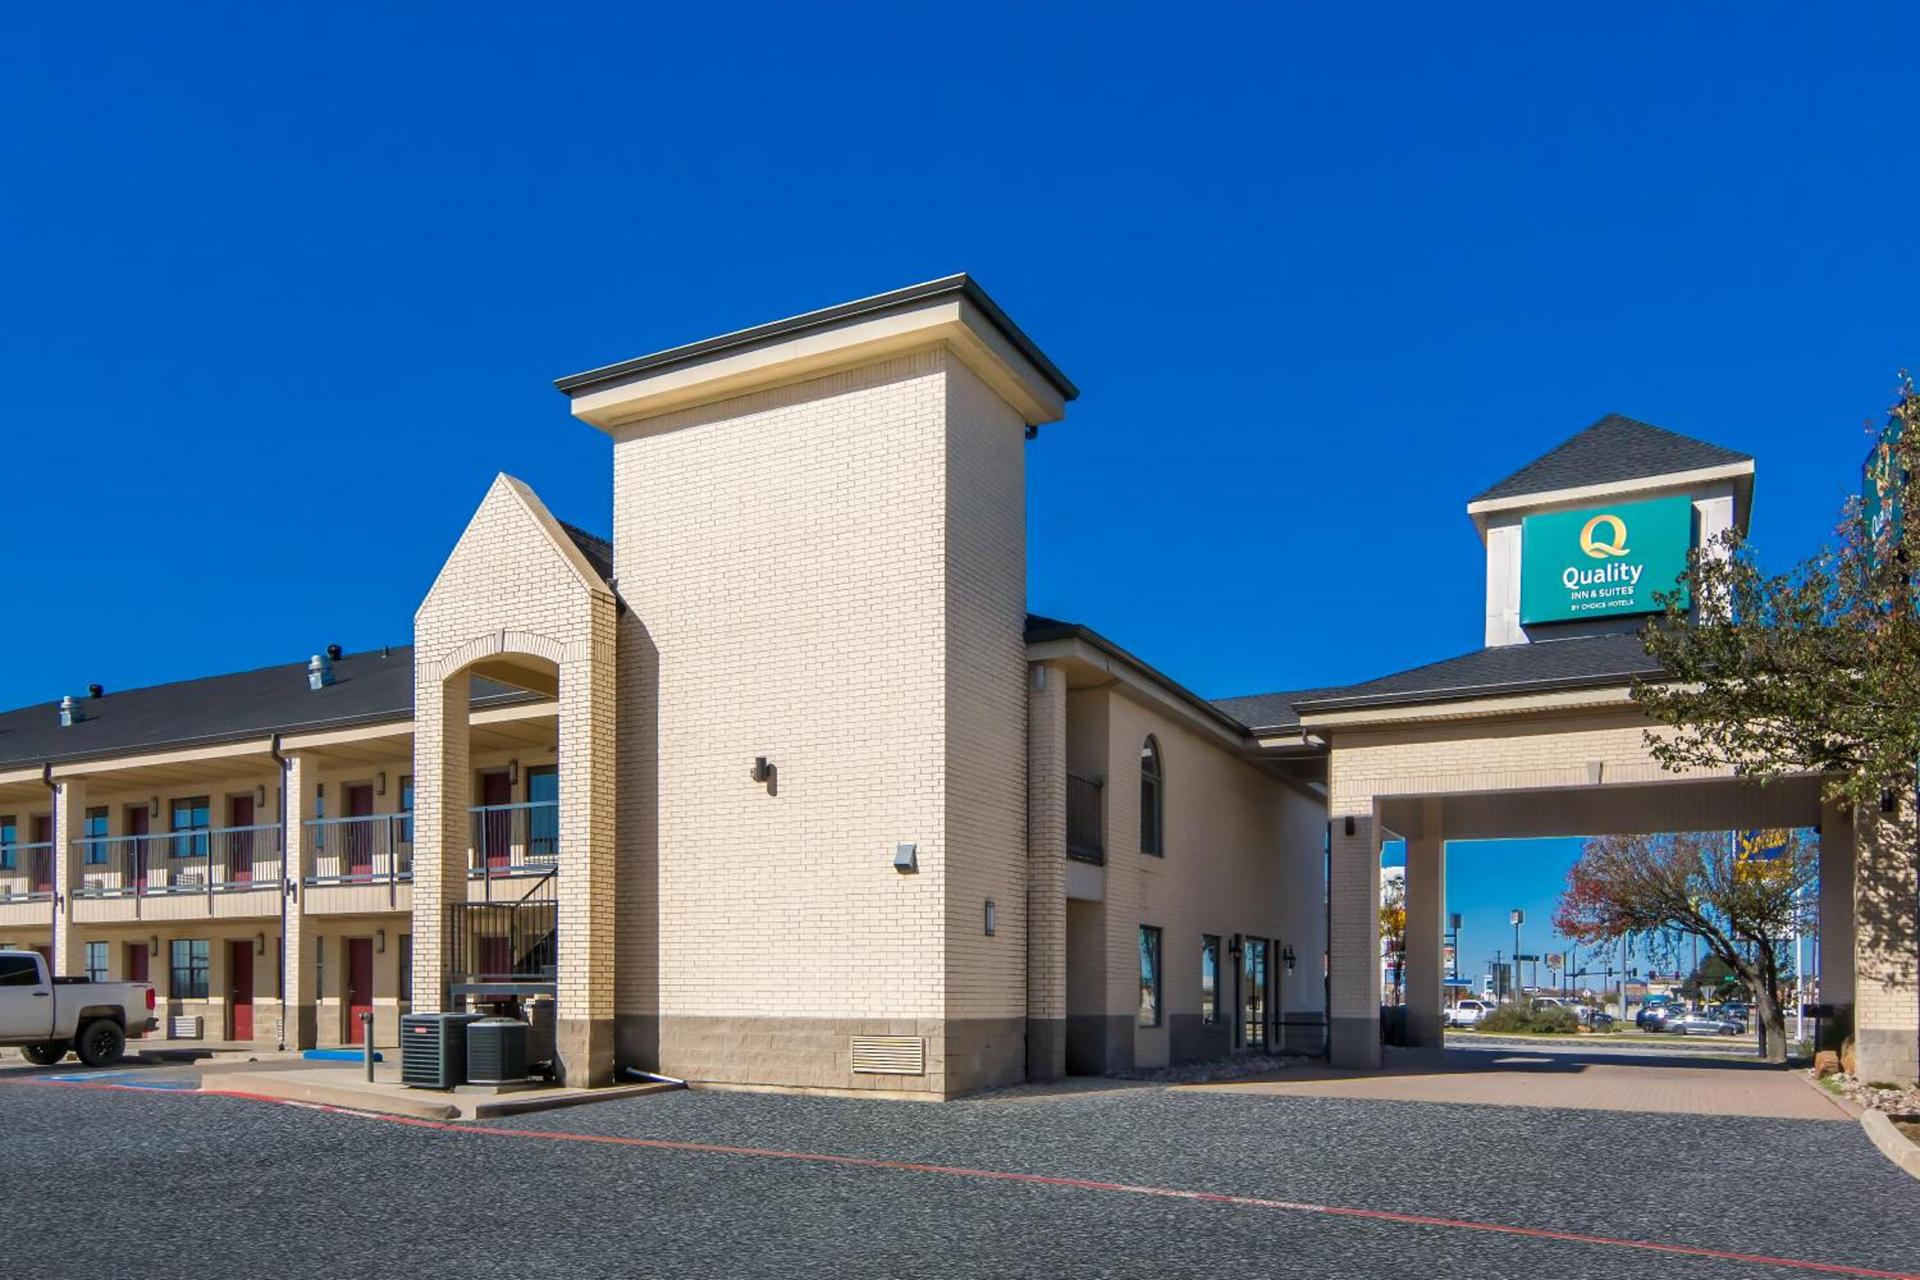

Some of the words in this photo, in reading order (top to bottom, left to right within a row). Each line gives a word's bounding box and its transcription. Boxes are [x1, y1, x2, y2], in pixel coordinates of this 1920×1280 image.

[1580, 514, 1630, 558] Q
[1562, 562, 1644, 590] Quality
[1571, 590, 1589, 600] INN
[1590, 589, 1598, 598] &
[1599, 585, 1635, 598] SUITES
